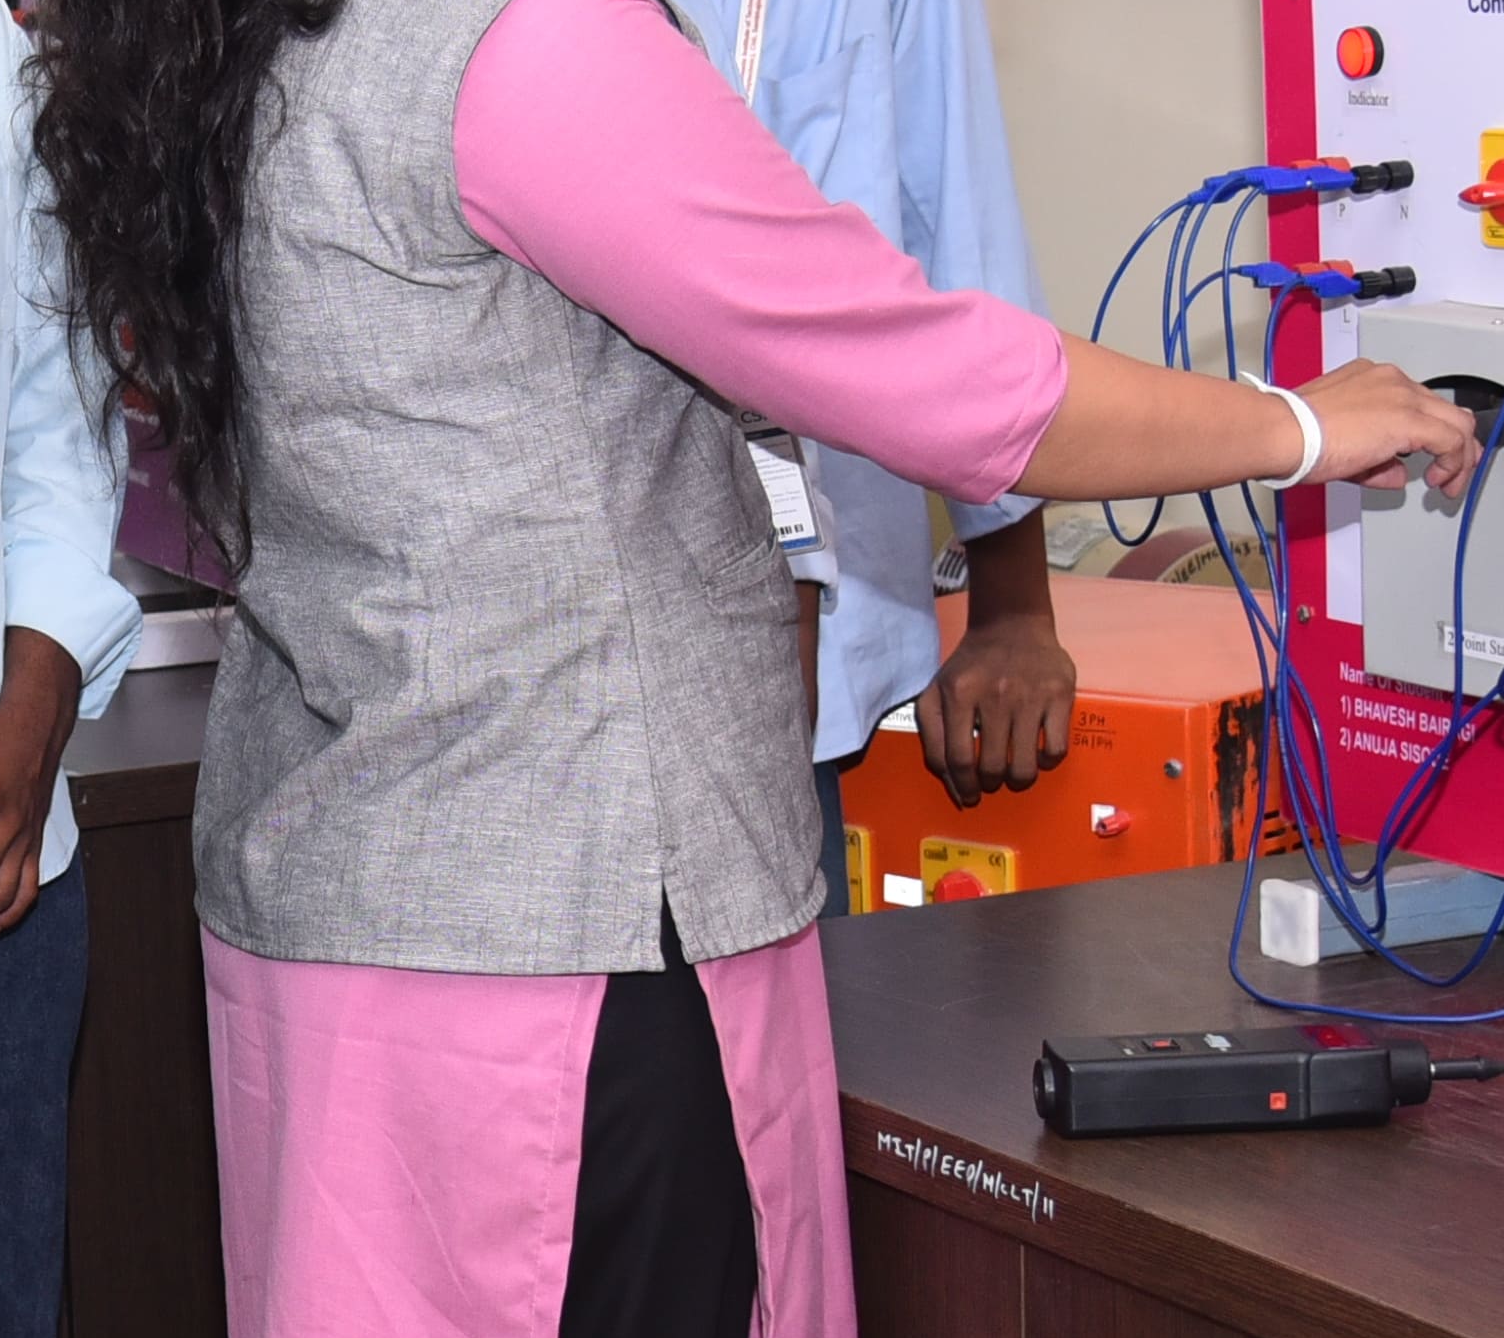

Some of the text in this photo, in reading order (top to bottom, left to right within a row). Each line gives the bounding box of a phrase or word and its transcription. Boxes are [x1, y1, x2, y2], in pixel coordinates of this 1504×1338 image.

[1352, 696, 1477, 743] BHAVESH BAIRGI
[1352, 730, 1398, 763] ANUJA
